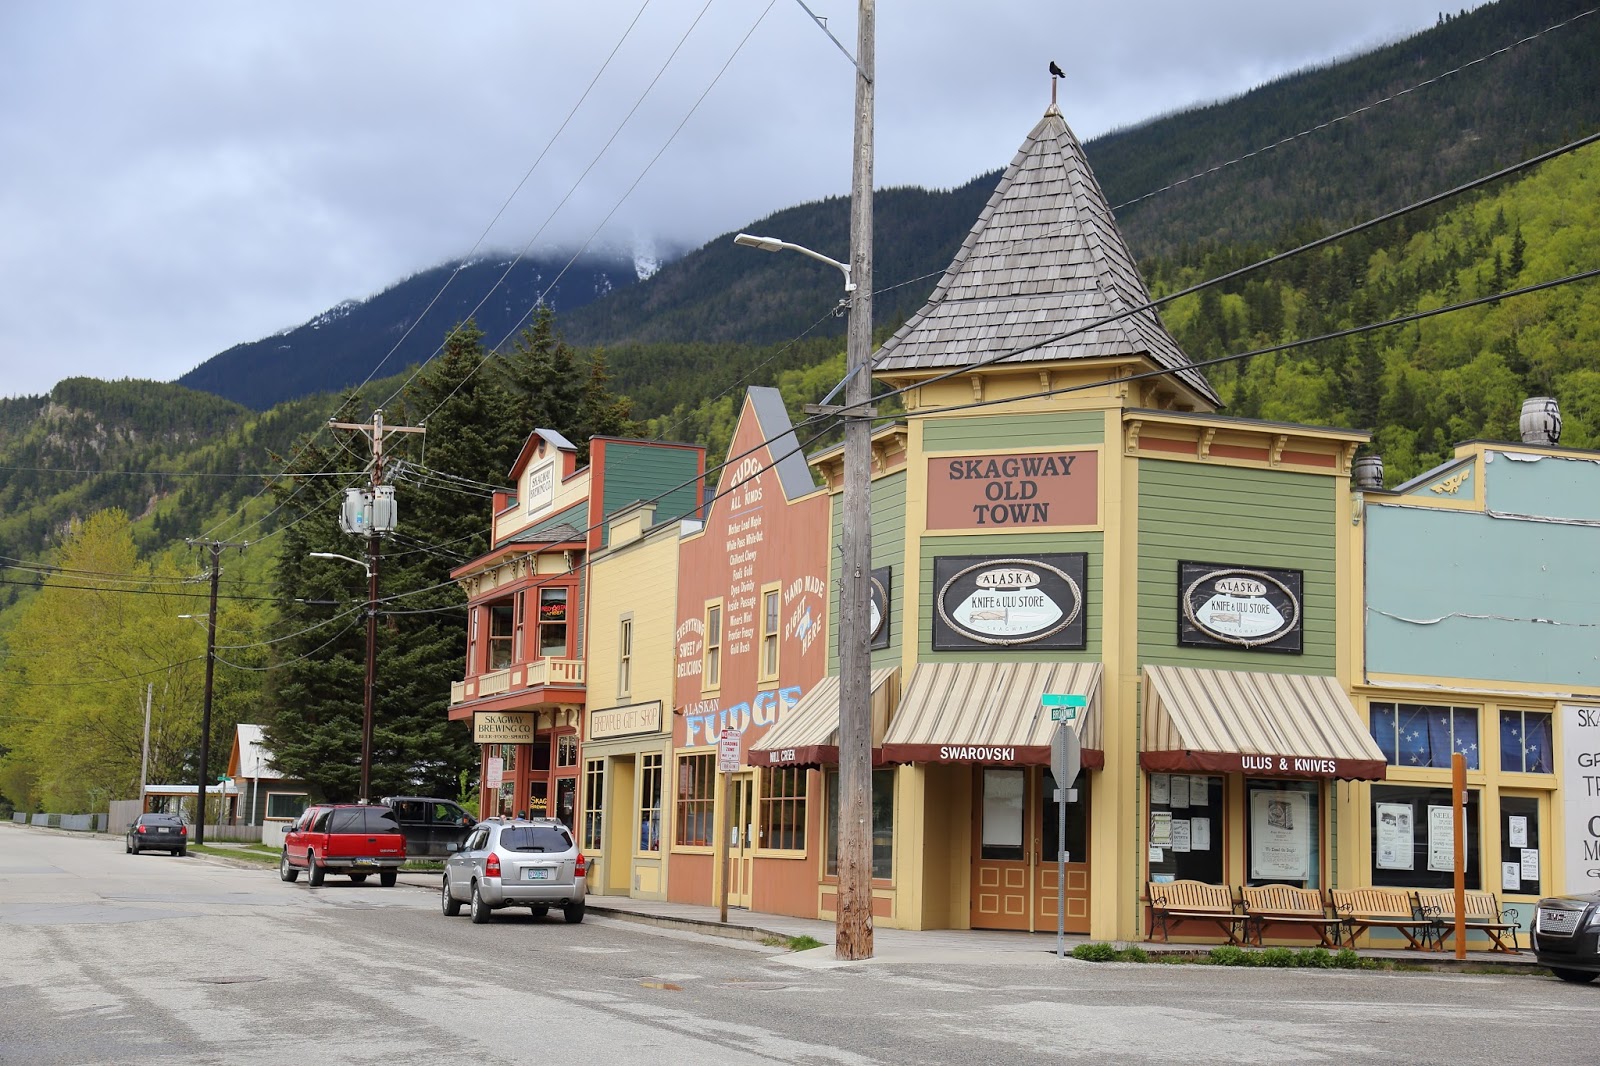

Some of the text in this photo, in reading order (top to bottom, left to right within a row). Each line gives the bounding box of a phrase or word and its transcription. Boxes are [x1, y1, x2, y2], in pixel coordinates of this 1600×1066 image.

[730, 457, 763, 495] FUDGE
[949, 456, 1076, 480] SKAGWAY
[730, 487, 762, 511] ALL KINDS
[985, 480, 1038, 501] OLD
[973, 502, 1049, 524] TOWN
[983, 573, 1032, 585] ALASKA
[1220, 581, 1261, 593] ALASKA
[784, 576, 825, 606] HAND MADE
[972, 596, 1044, 609] KNIFE & ULU STORE
[1211, 600, 1230, 611] KNIFE
[1236, 602, 1248, 613] ULU
[1249, 603, 1270, 614] STORE
[785, 595, 807, 641] RIGHT
[676, 618, 705, 642] EVERYTHING
[802, 613, 822, 657] HERE
[680, 641, 695, 658] SWEET
[683, 699, 720, 716] ALASKAN
[685, 686, 802, 747] FUDGE
[478, 724, 517, 732] BREWING
[485, 715, 525, 724] SKAGWAY
[624, 711, 638, 728] GIFT
[641, 708, 657, 726] SHOP
[940, 746, 1015, 760] SWAROVSKI
[1242, 756, 1336, 773] ULUS & KNIVES
